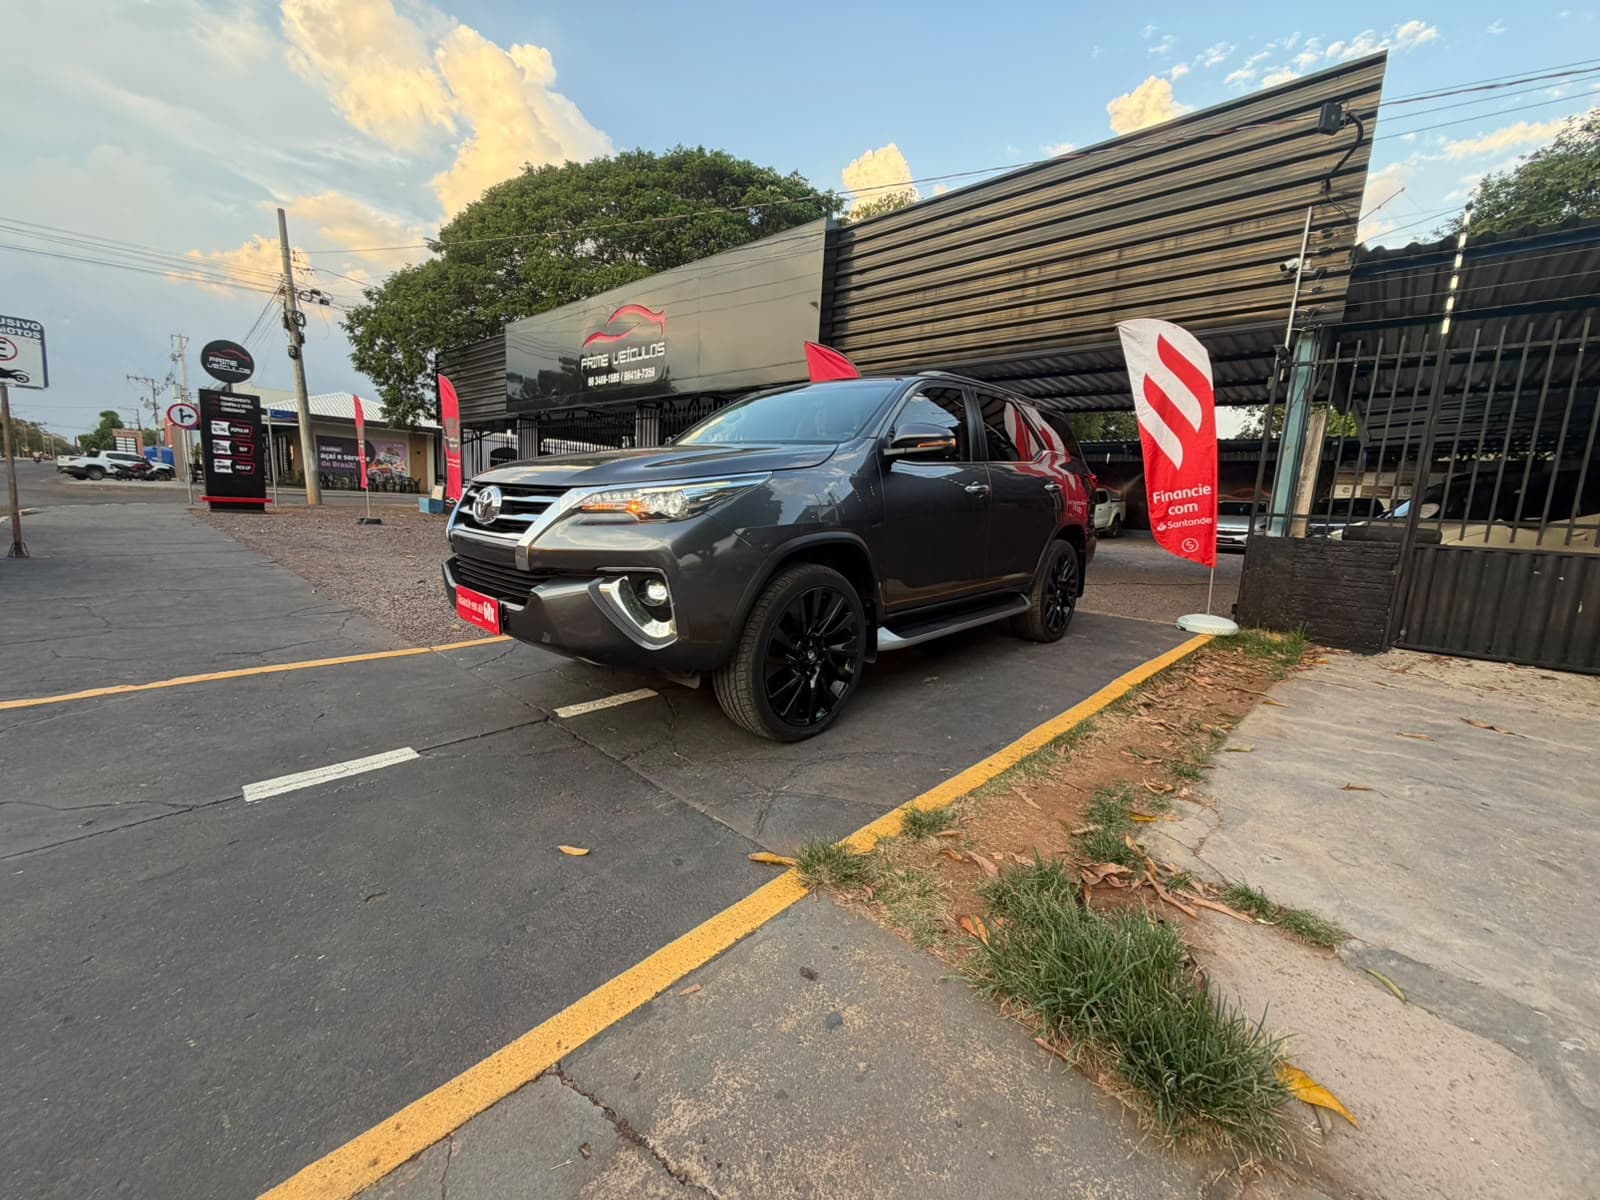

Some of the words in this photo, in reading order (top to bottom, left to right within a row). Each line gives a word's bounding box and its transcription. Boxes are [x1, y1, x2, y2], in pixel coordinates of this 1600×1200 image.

[209, 356, 238, 367] PRIME
[581, 354, 608, 371] PRIME
[320, 451, 336, 461] açaí
[1153, 484, 1211, 504] Financie
[1168, 502, 1199, 515] com
